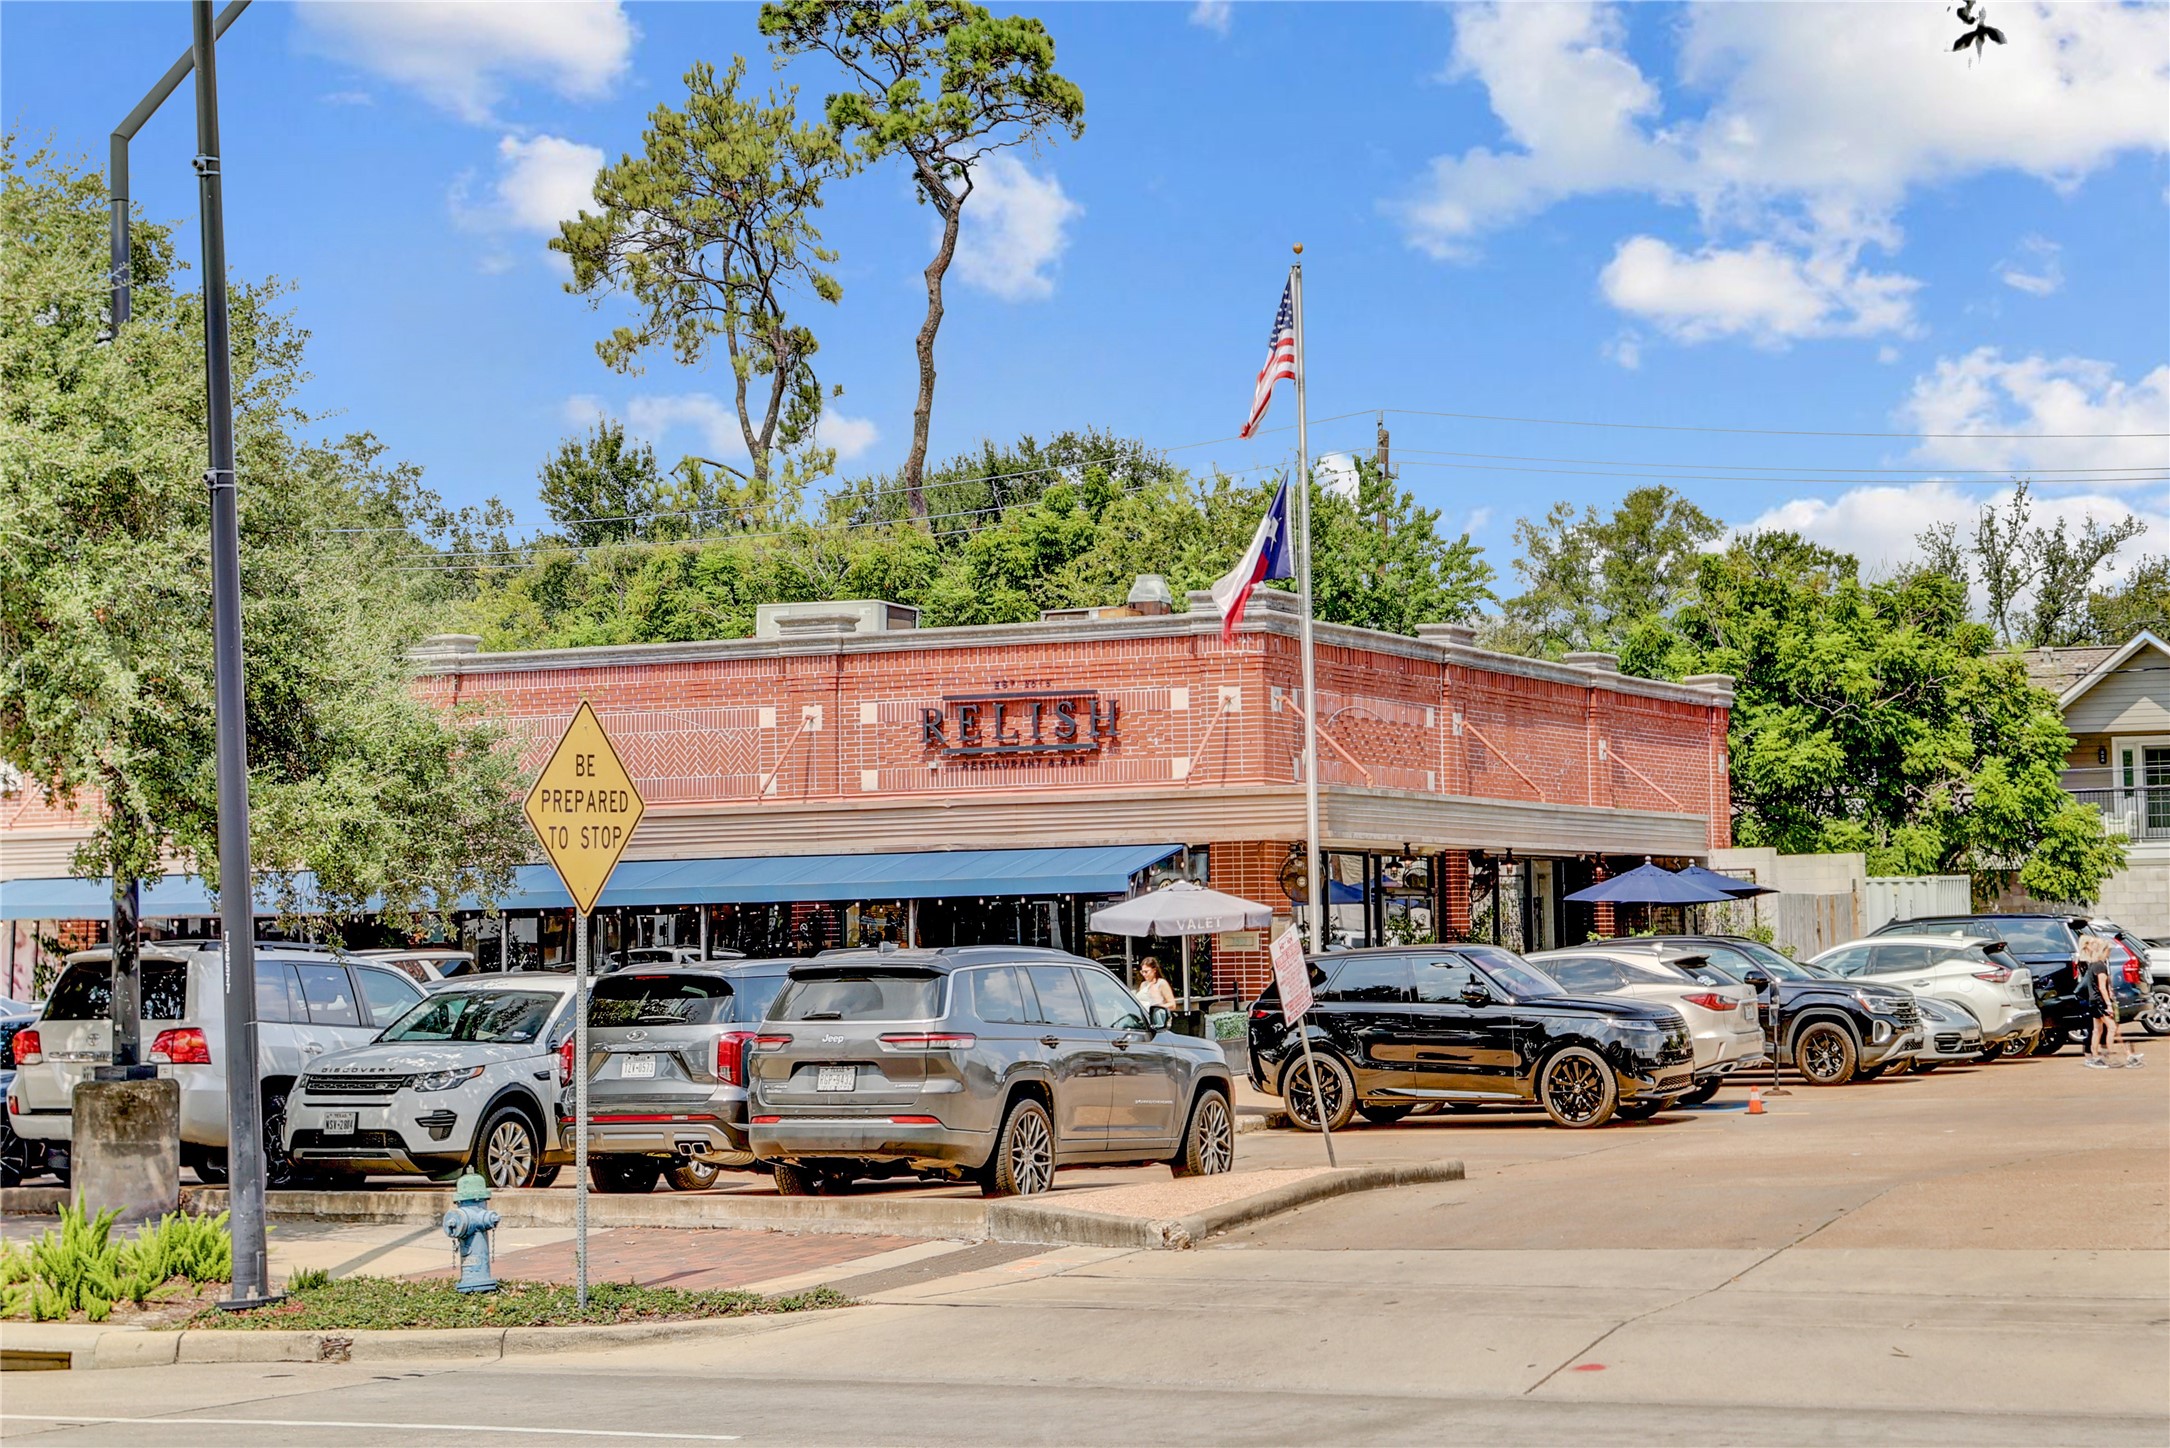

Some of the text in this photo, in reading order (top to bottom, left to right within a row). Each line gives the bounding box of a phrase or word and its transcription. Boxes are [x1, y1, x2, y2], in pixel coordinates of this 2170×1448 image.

[918, 700, 1119, 744] RELISH
[576, 754, 595, 777] BE
[962, 757, 1041, 771] RESTAURANT
[1060, 756, 1086, 768] BAR
[541, 790, 629, 813] PREPARED
[549, 826, 622, 849] TO STOP
[1176, 916, 1222, 930] VALET
[822, 1033, 844, 1044] Jeep
